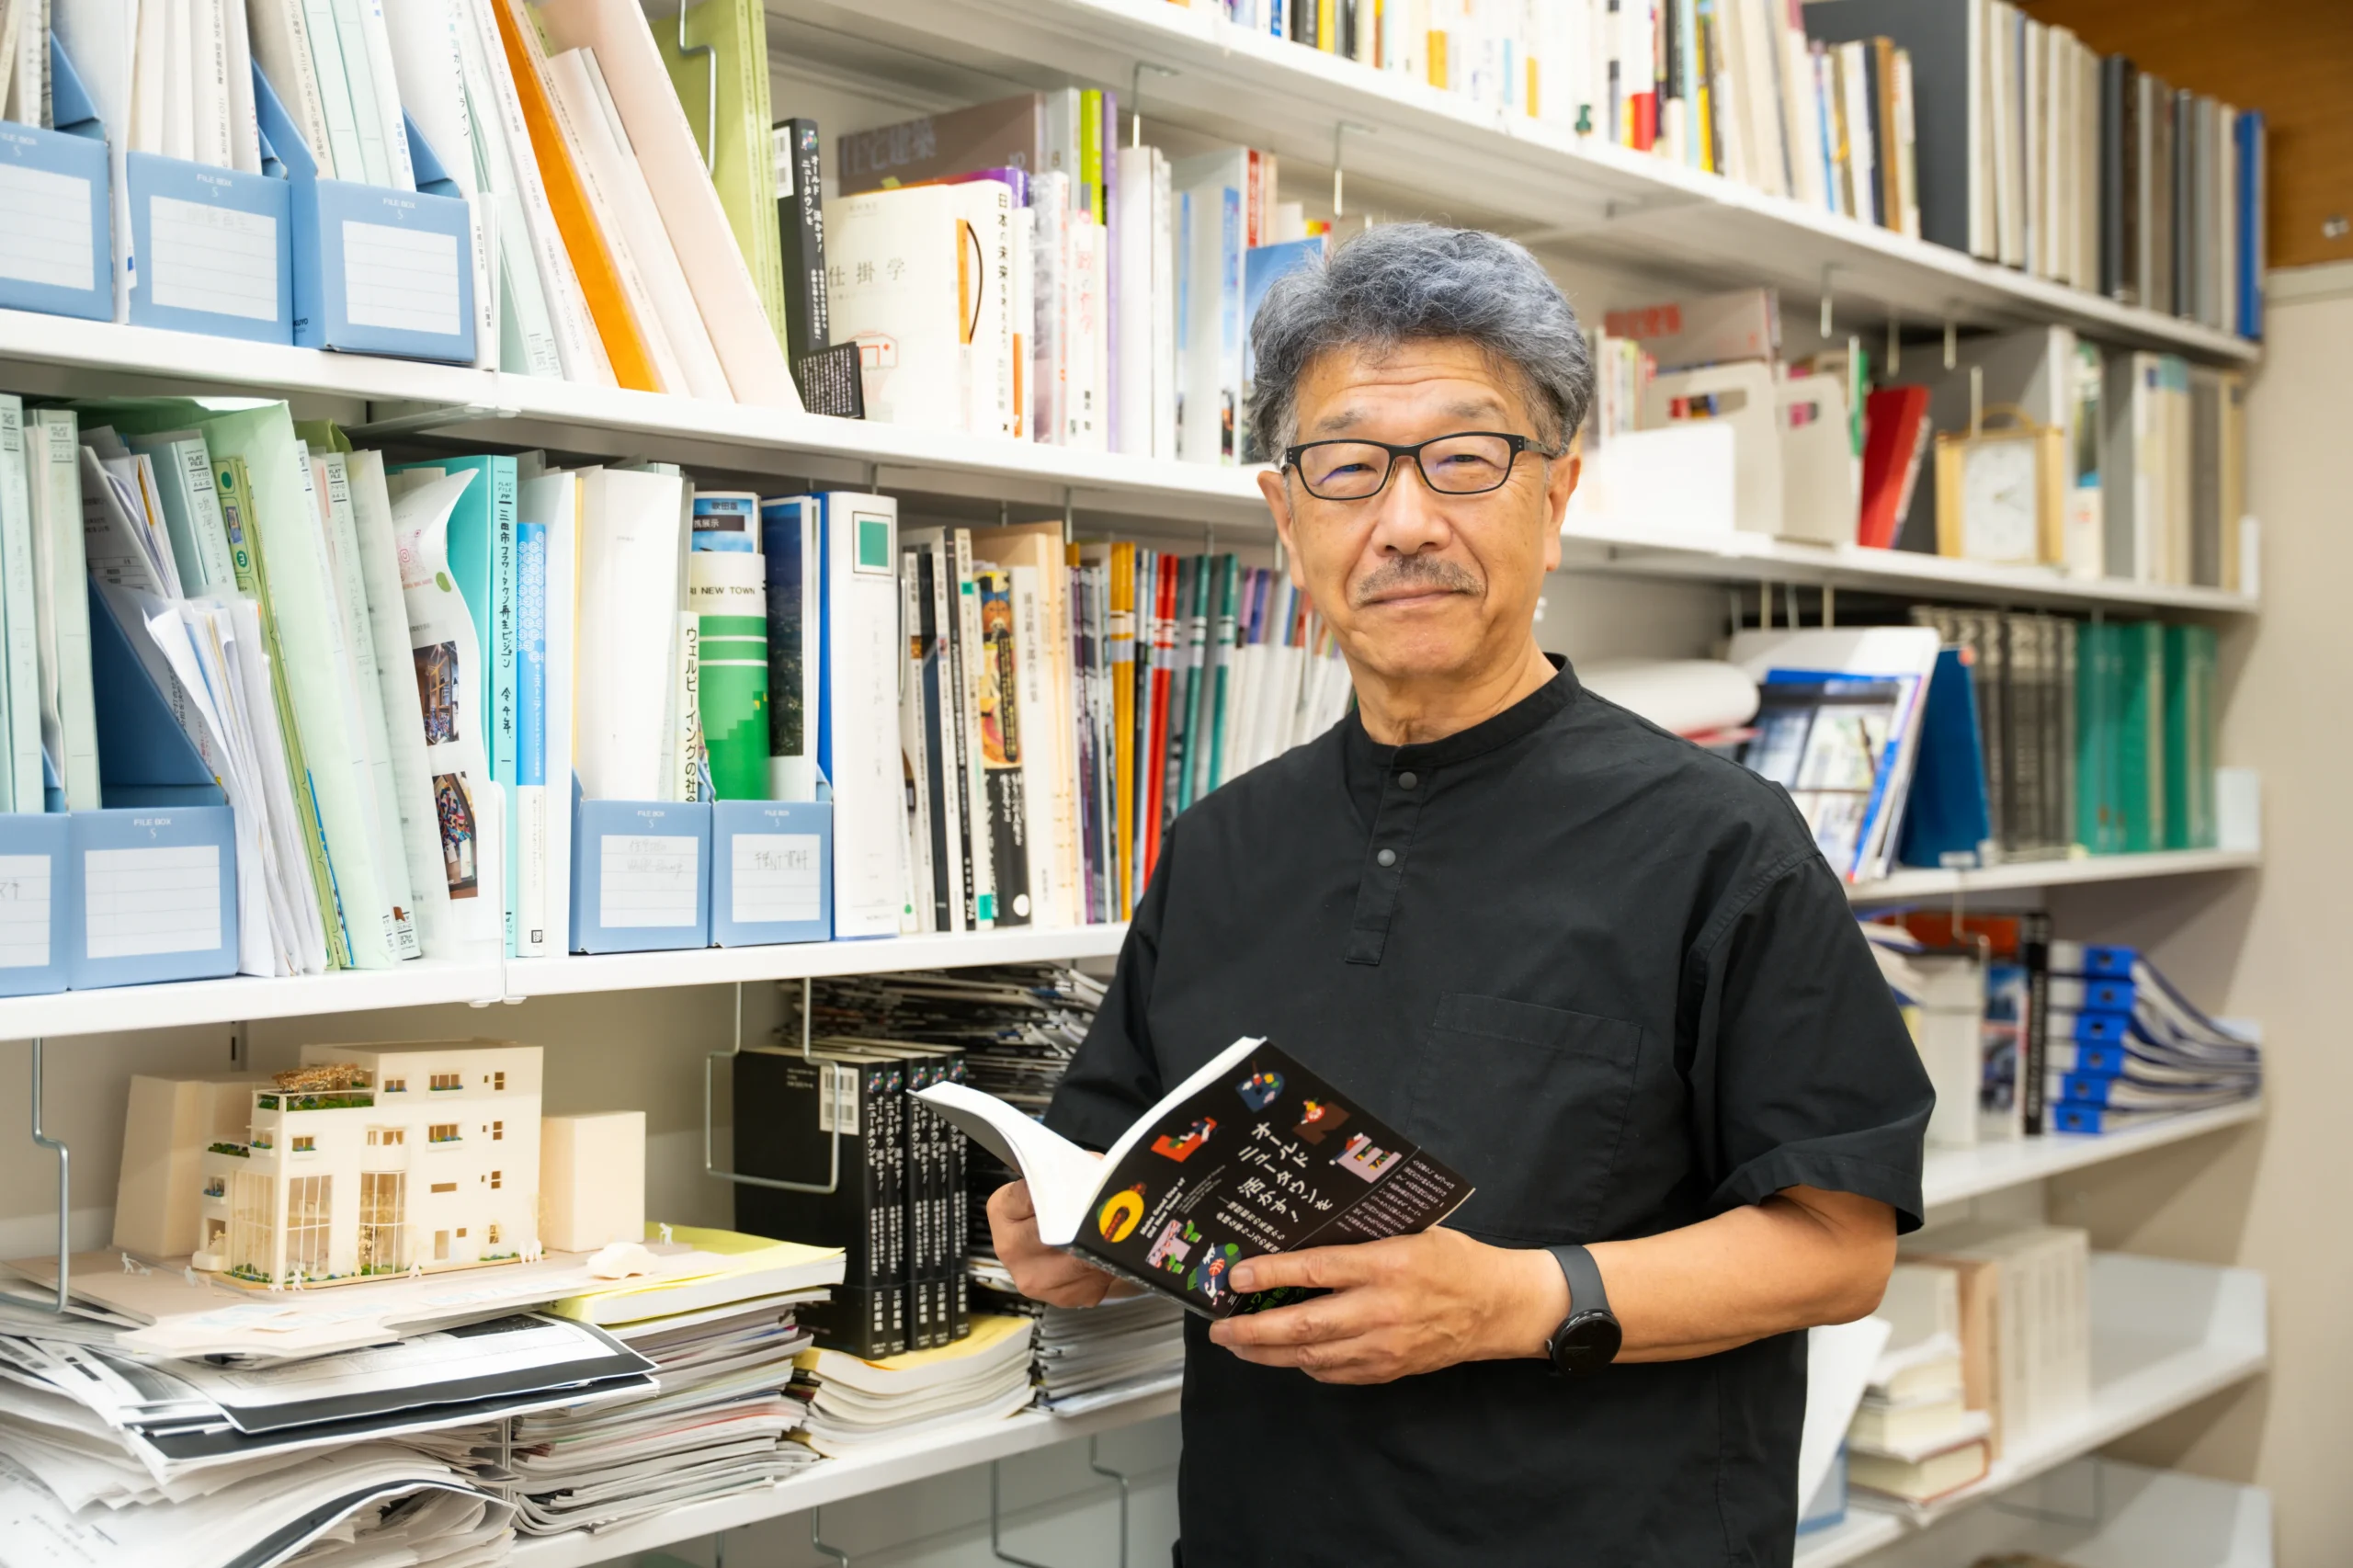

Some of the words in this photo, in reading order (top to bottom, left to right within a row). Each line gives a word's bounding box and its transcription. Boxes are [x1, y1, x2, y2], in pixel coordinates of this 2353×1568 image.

[801, 159, 813, 226] ニュータウンを
[810, 154, 820, 196] オールド
[383, 198, 399, 207] FILE
[401, 200, 416, 209] BOX
[700, 586, 724, 596] NEW
[730, 586, 756, 596] TOWN
[867, 1102, 877, 1167] ニュータウンを
[875, 1095, 884, 1136] オールド
[885, 1101, 895, 1165] ニュータウンを
[893, 1094, 903, 1134] オールド
[1251, 1121, 1309, 1168] オールド
[1238, 1146, 1333, 1211] ニュータウンを
[1140, 1215, 1155, 1235] Make
[1153, 1198, 1168, 1216] Good
[1165, 1186, 1178, 1199] Use
[1176, 1176, 1186, 1187] of
[1146, 1225, 1158, 1239] Old
[1154, 1210, 1168, 1226] New
